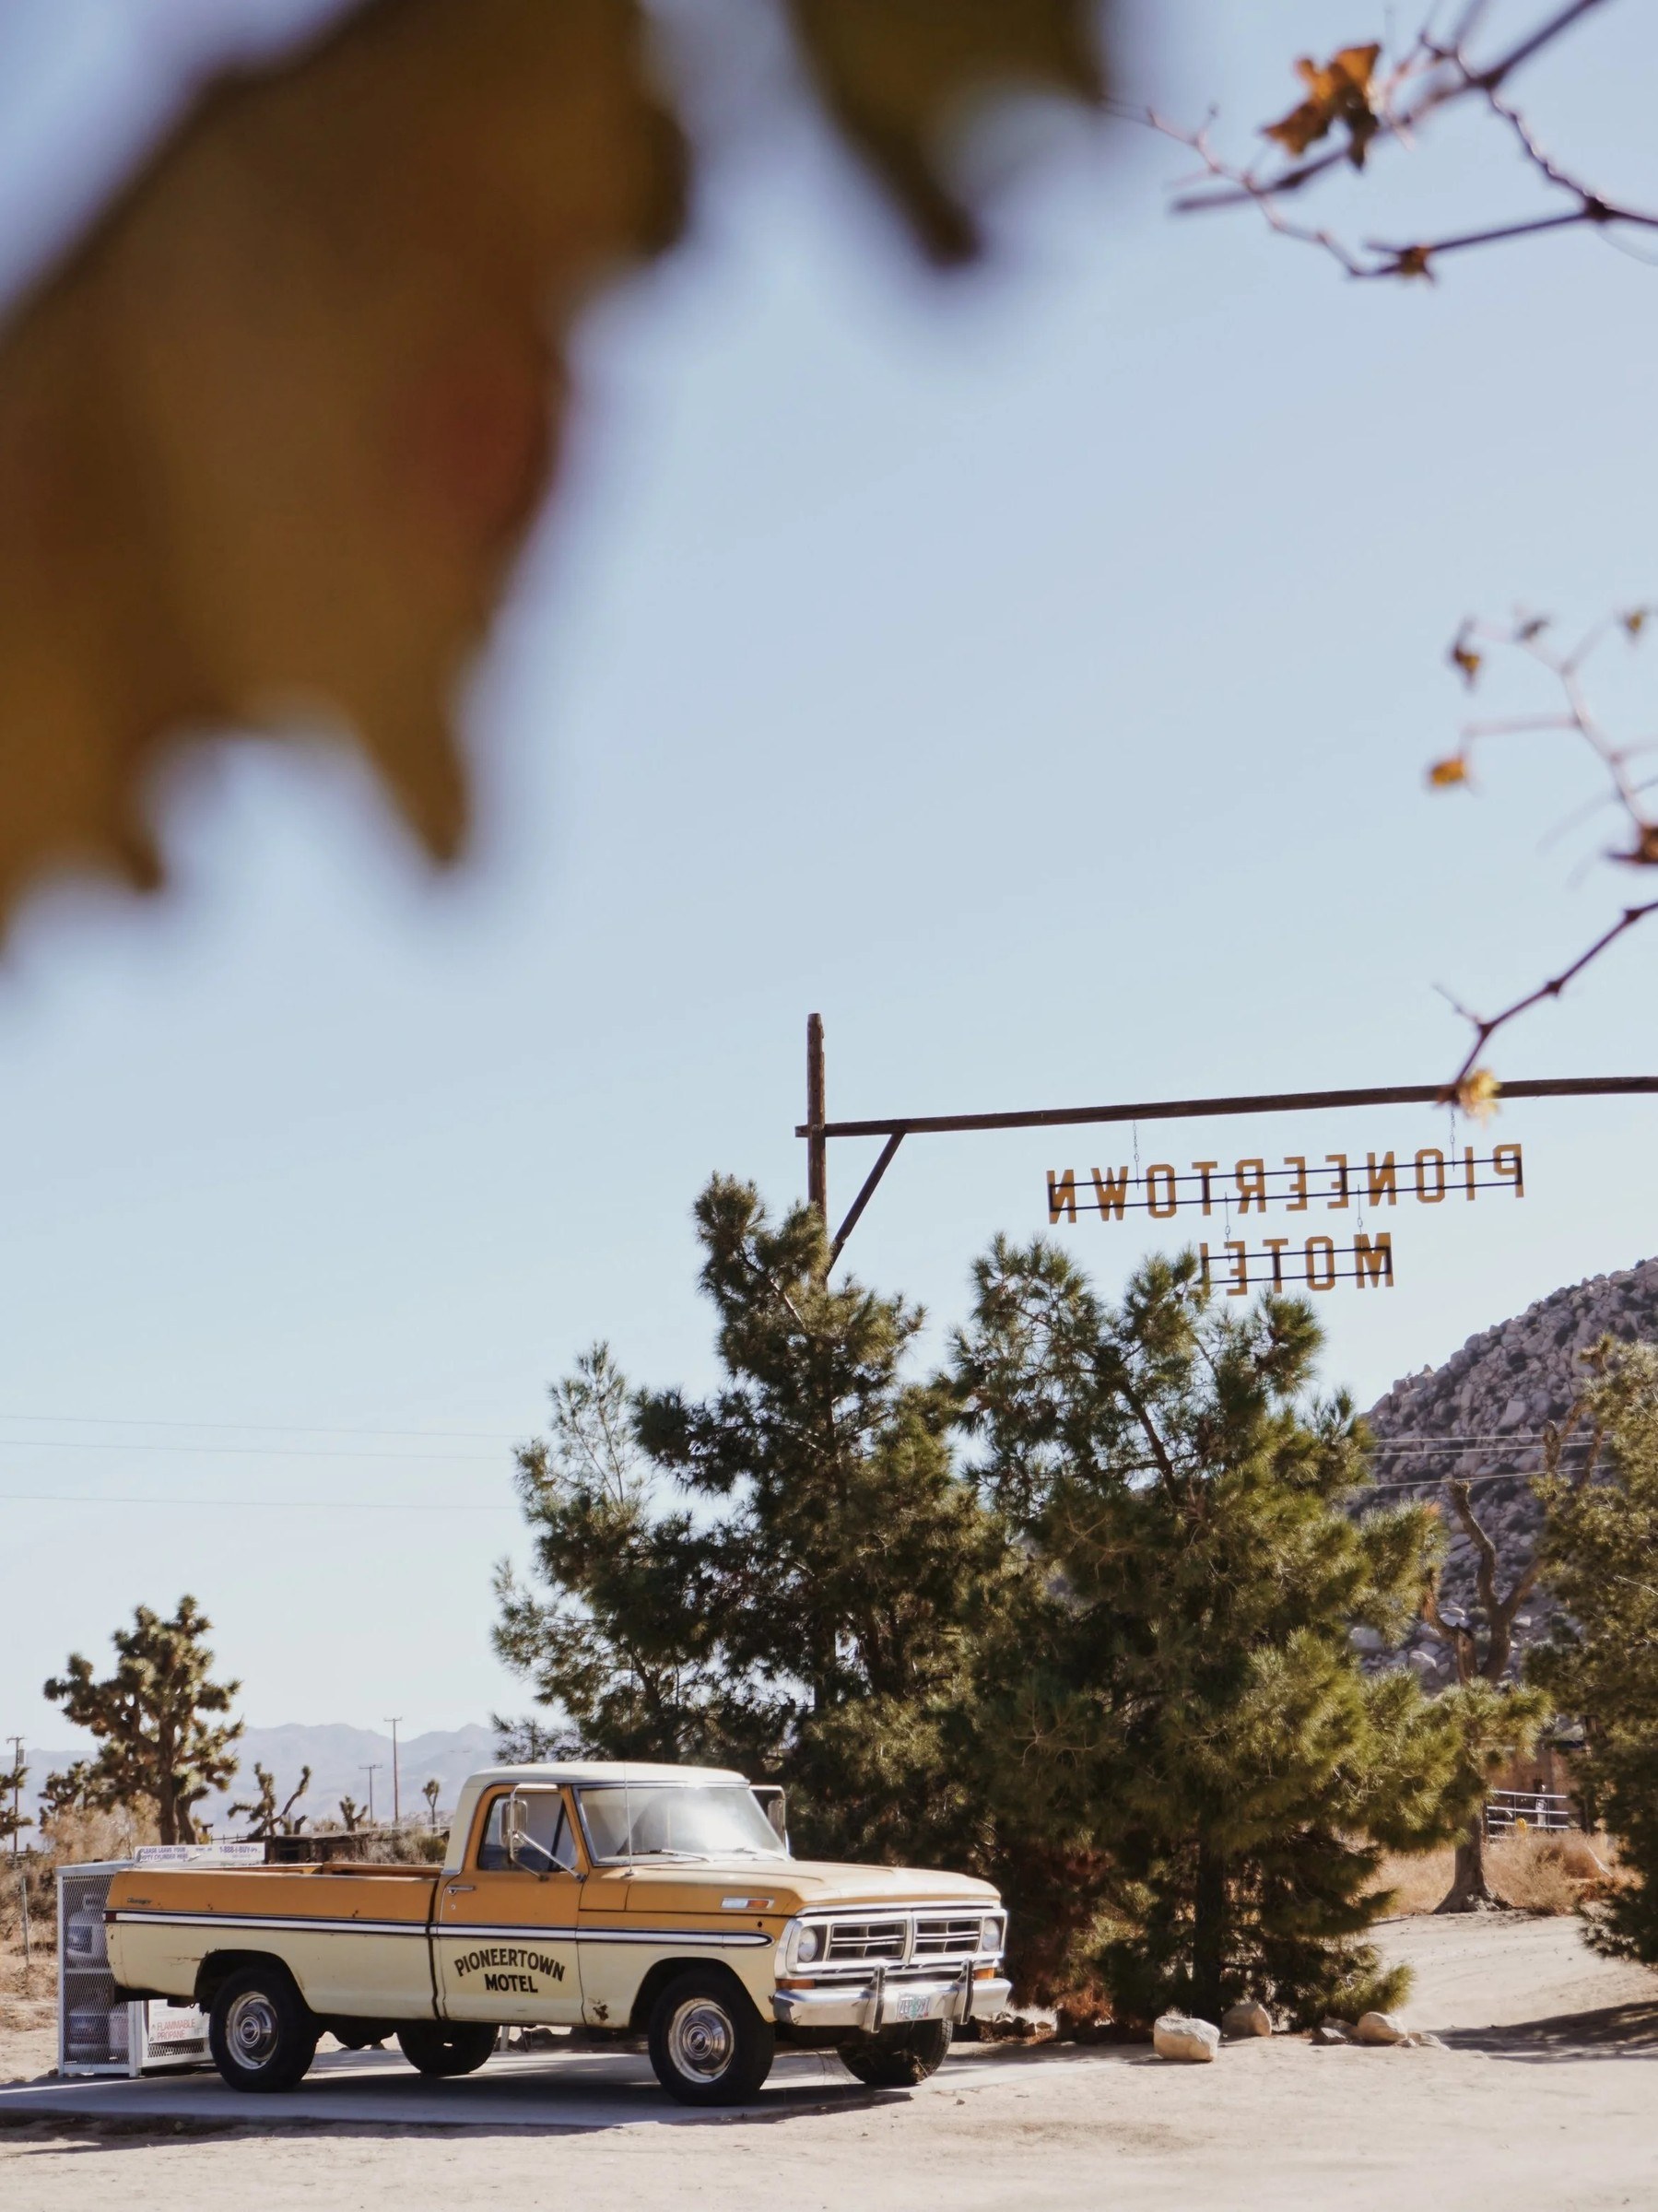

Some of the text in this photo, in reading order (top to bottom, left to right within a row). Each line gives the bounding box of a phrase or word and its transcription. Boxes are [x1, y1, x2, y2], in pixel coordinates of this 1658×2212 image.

[453, 1947, 566, 1983] PIONEERTOWN
[484, 1973, 539, 1994] MOTEL
[157, 2018, 196, 2031] FLAMMABLE
[157, 2030, 186, 2041] PROPANE
